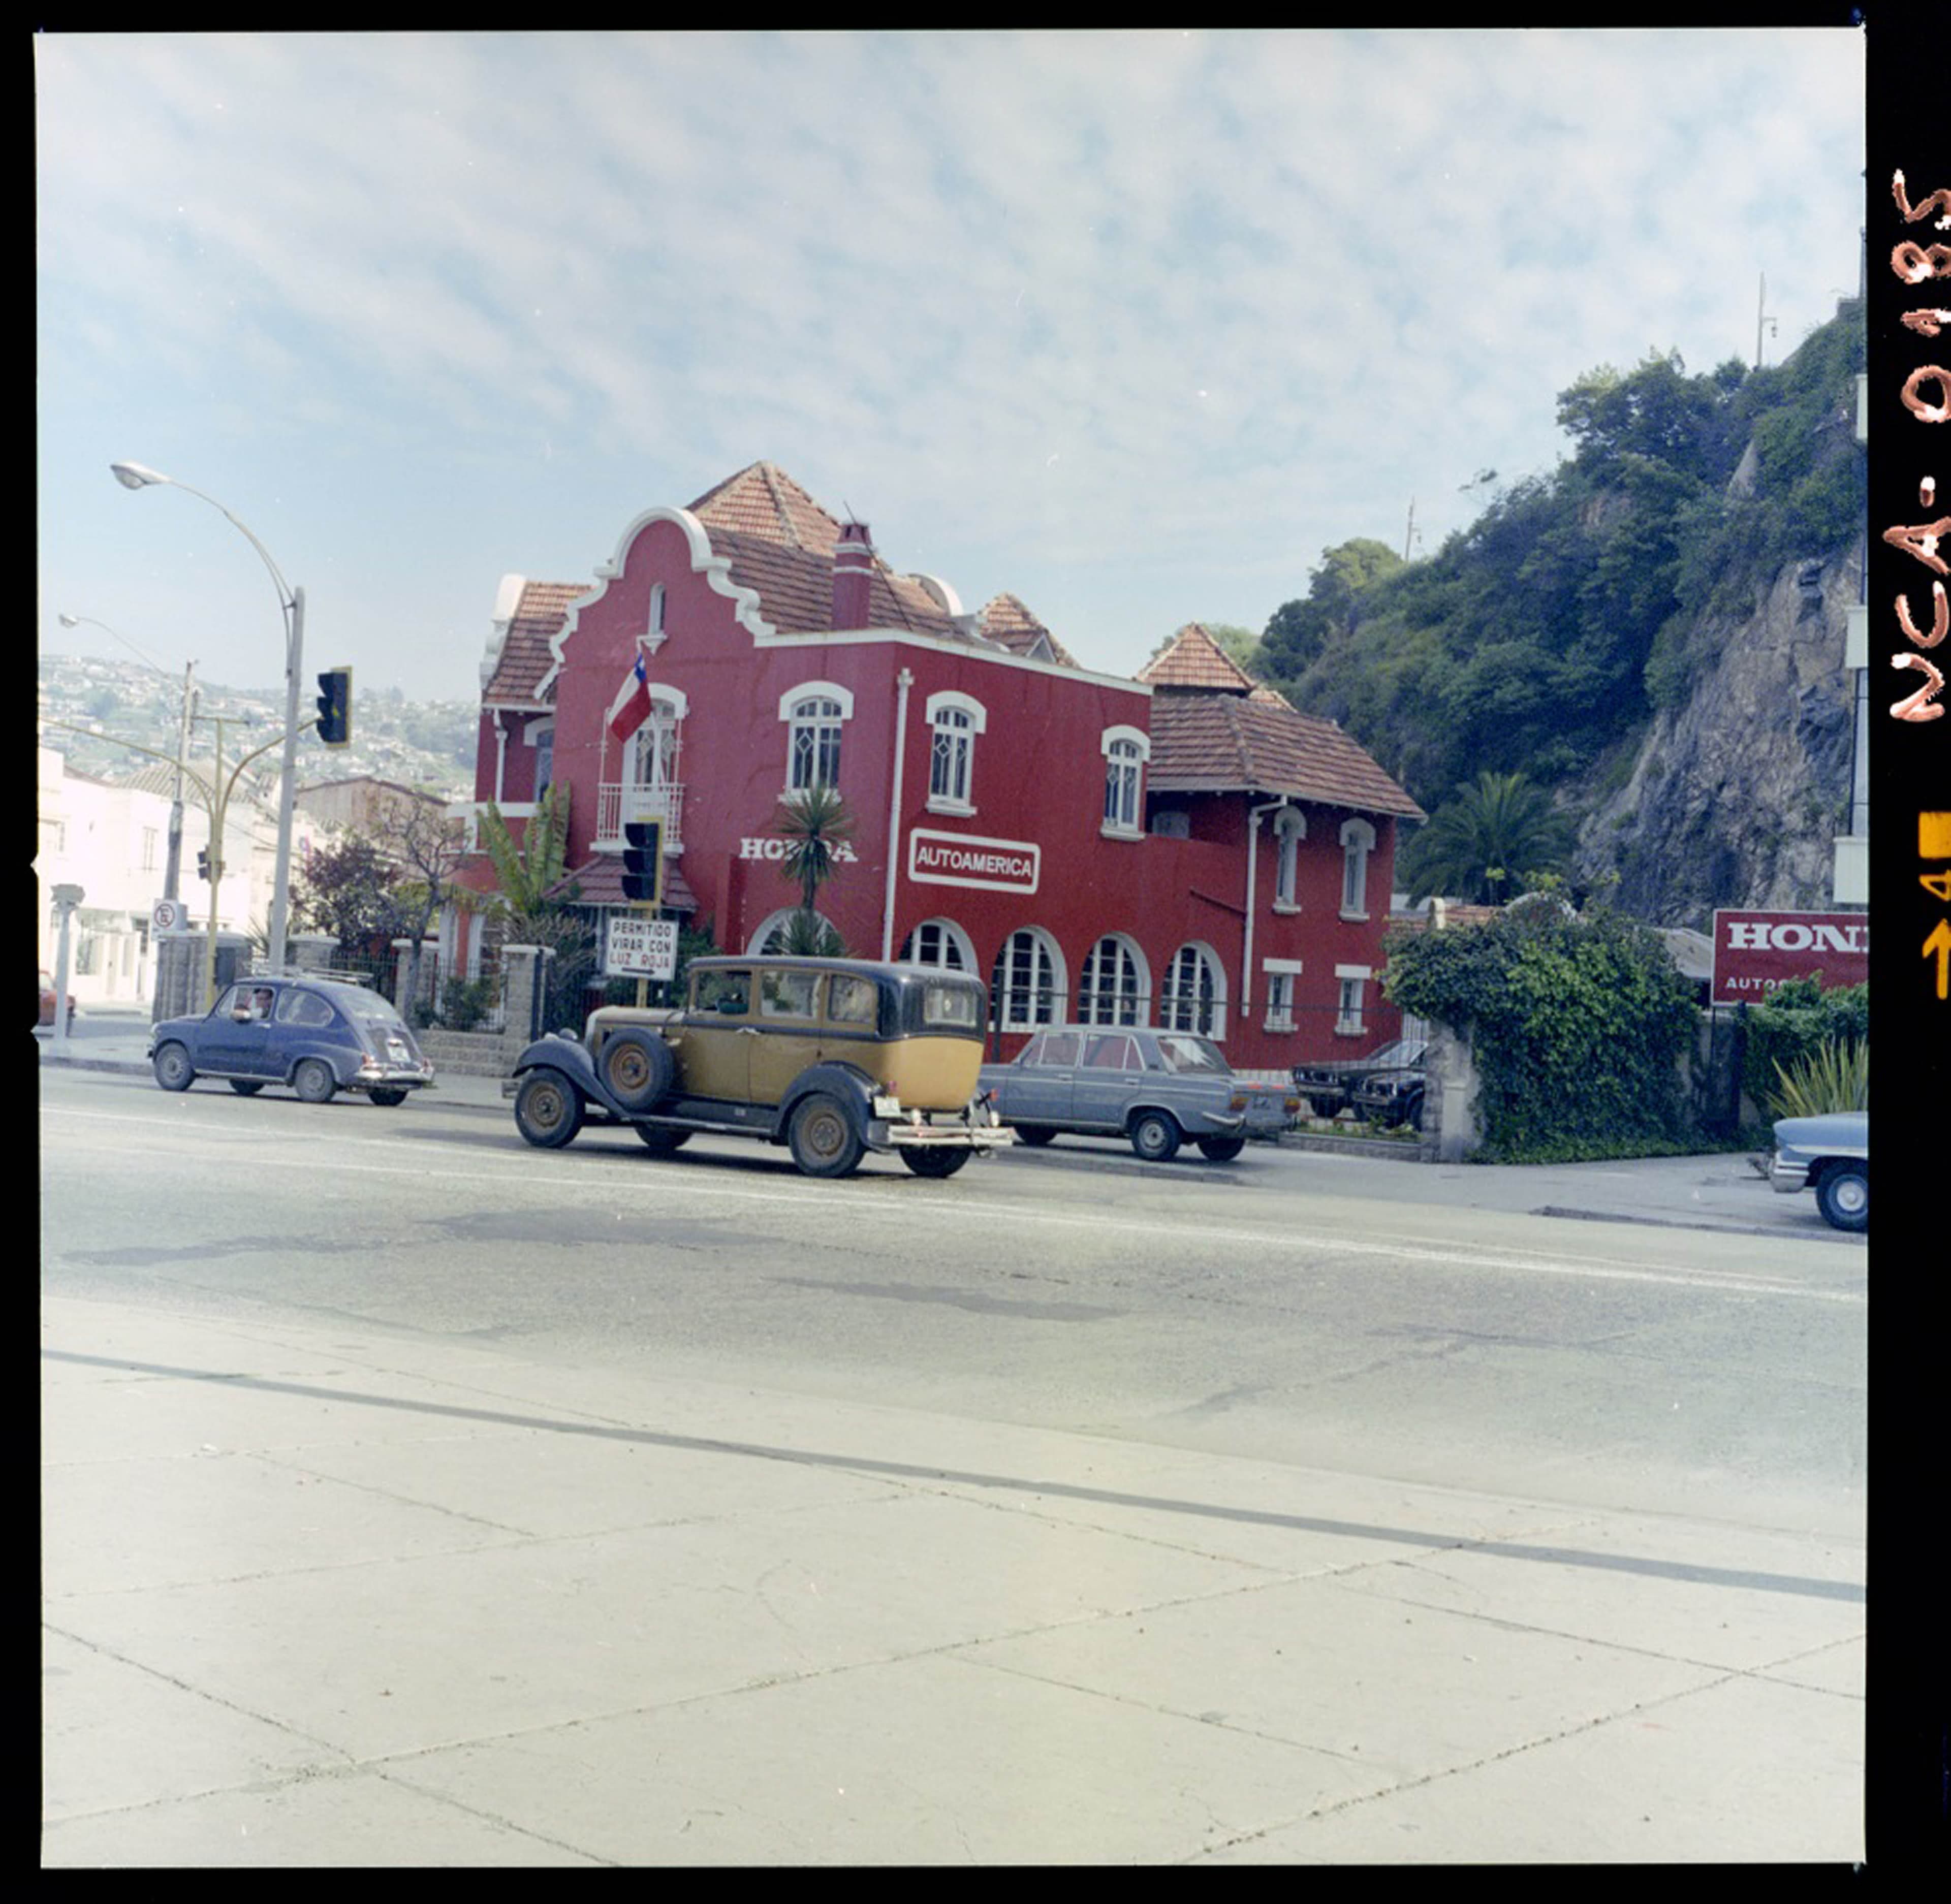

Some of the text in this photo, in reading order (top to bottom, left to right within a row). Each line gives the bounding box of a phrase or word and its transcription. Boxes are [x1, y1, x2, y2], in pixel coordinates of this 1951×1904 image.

[916, 846, 1032, 877] AUTOAMERICA
[614, 921, 671, 937] PERMITIDO
[1727, 922, 1869, 953] HON
[611, 937, 671, 953] VIRAR CON
[610, 951, 670, 969] LUZ ROJA
